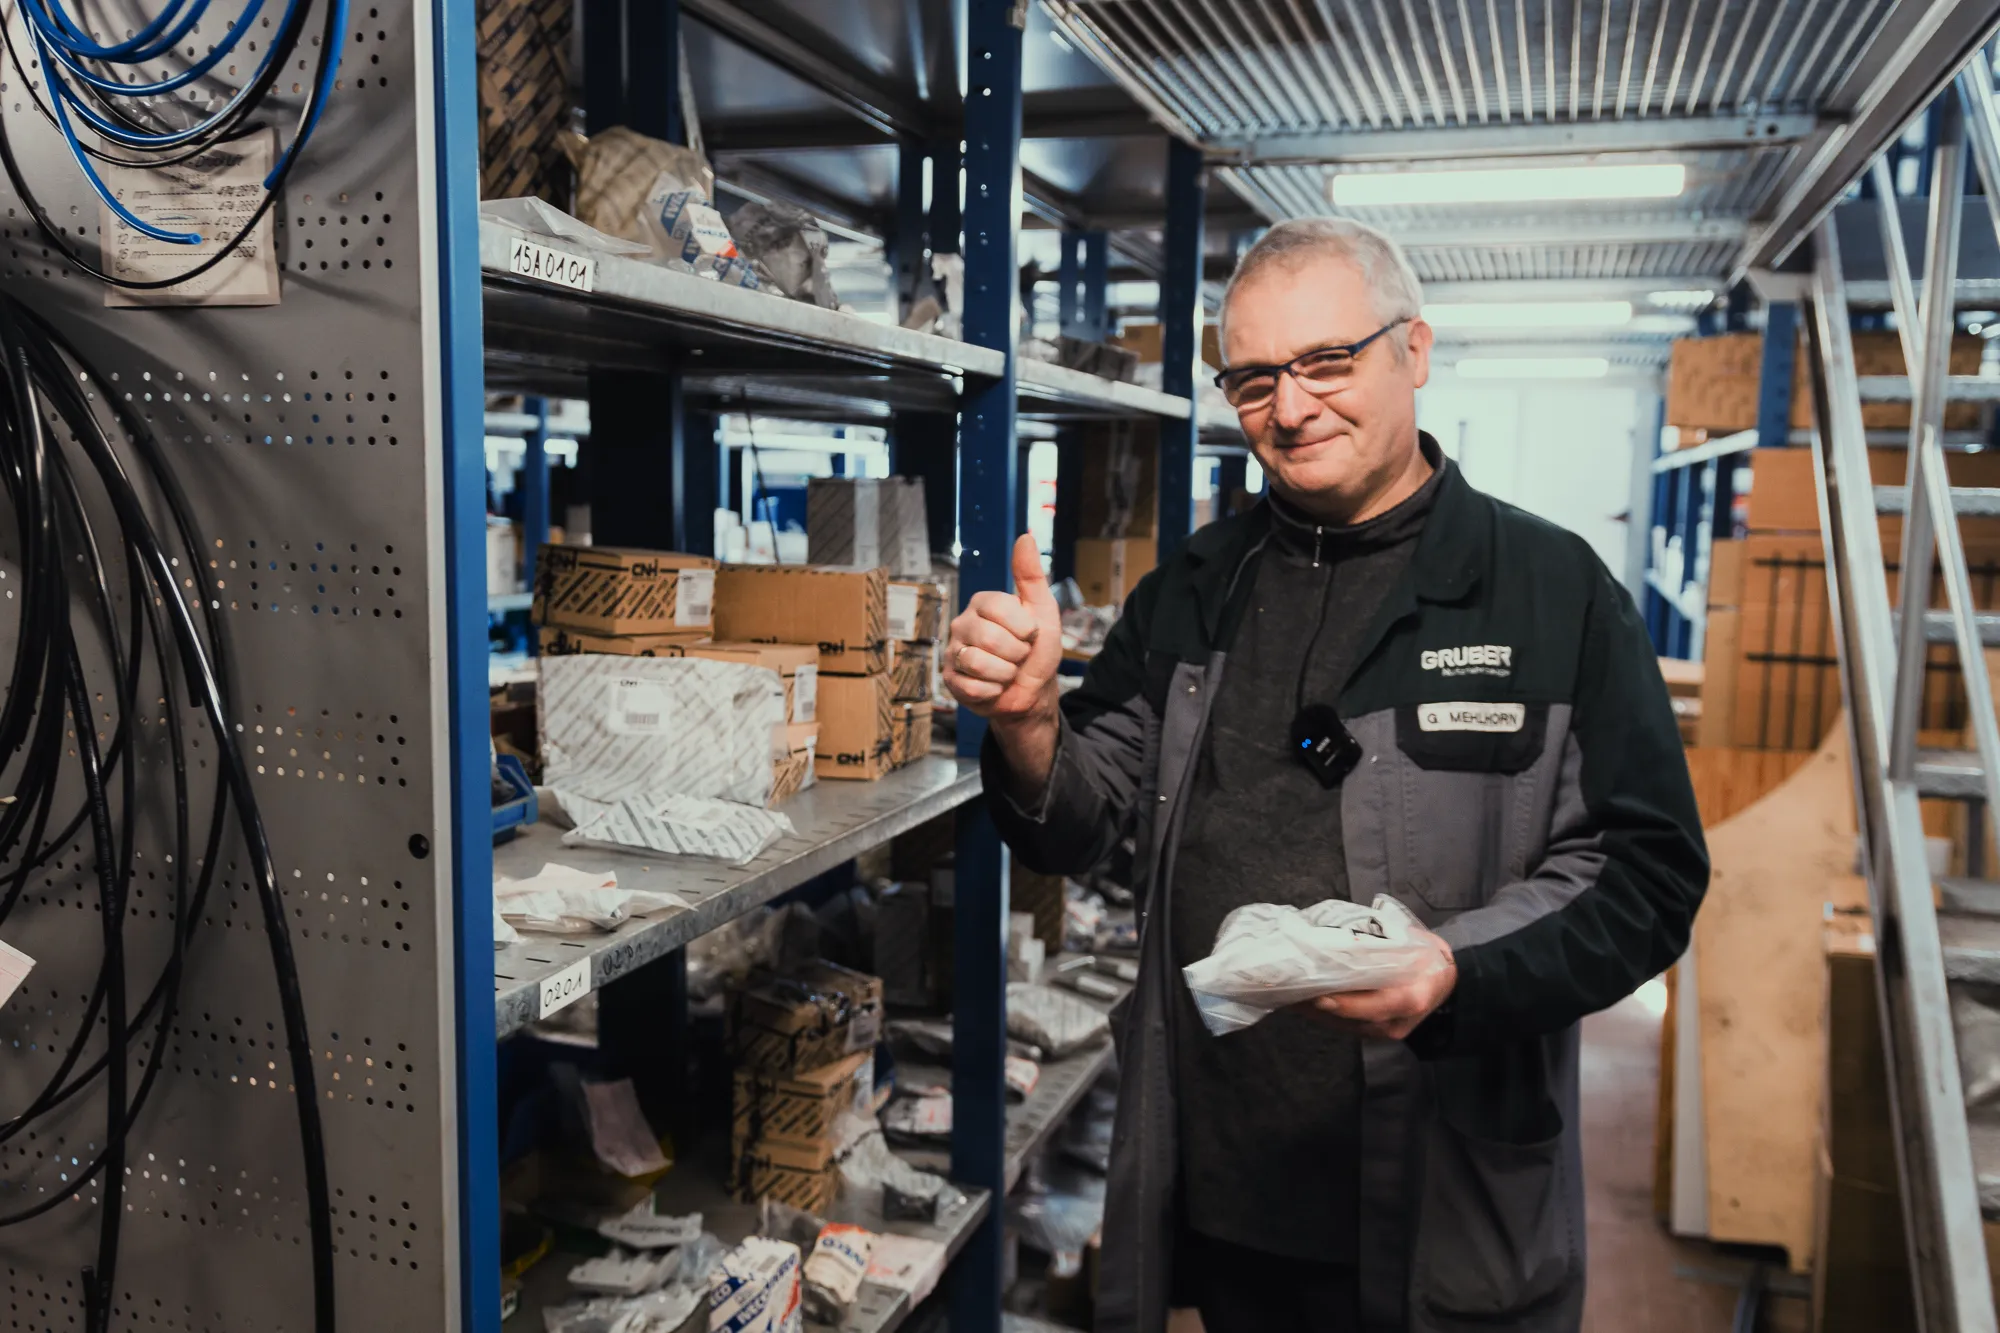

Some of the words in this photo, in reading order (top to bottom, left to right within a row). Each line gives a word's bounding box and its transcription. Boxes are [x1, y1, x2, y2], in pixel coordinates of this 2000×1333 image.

[1420, 645, 1512, 670] GRUBER
[1449, 711, 1517, 724] MEHLHORN
[543, 971, 583, 1008] 0201
